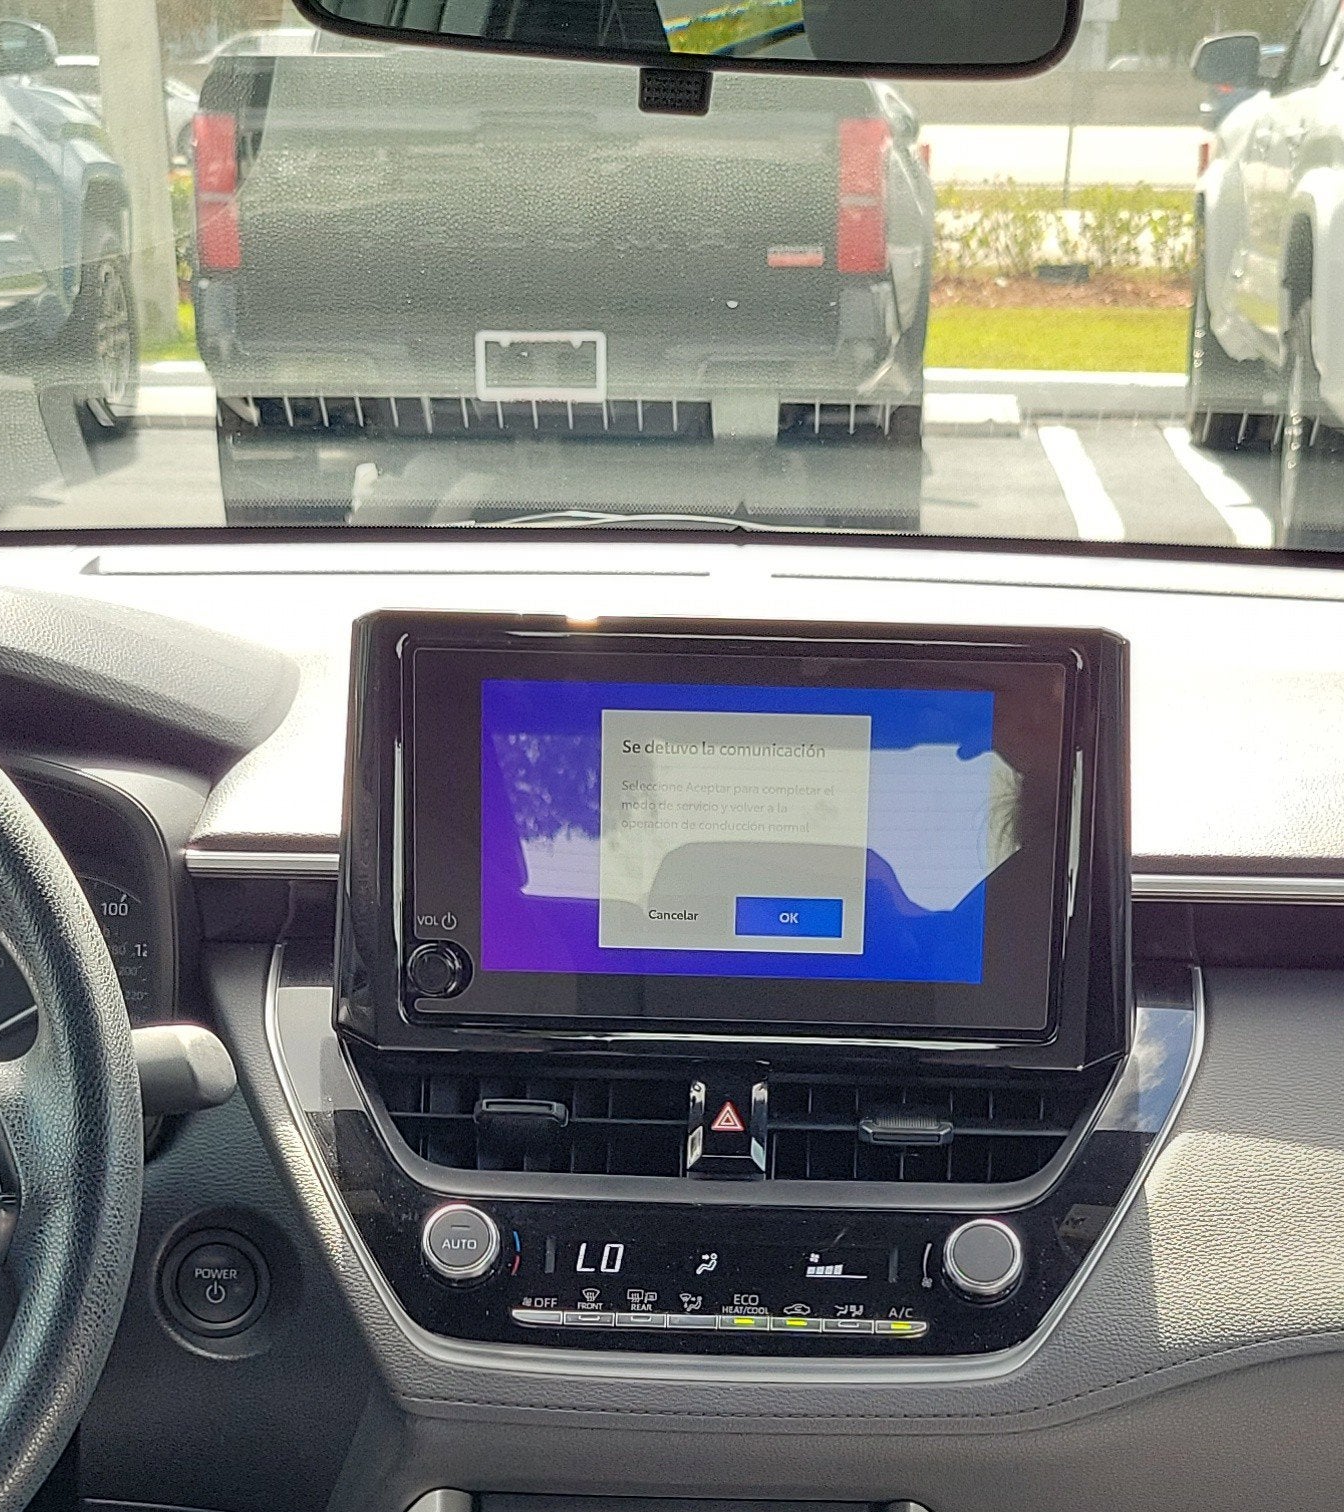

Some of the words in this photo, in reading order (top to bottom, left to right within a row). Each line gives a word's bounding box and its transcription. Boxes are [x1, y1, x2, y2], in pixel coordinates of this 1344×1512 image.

[622, 739, 641, 754] Se
[644, 739, 699, 755] detuvo
[702, 741, 715, 756] la
[719, 742, 826, 758] comunicación
[621, 780, 683, 792] Seleccione
[686, 782, 731, 795] Aceptar
[733, 785, 759, 796] para
[762, 784, 821, 797] completar
[823, 785, 835, 796] el
[621, 799, 656, 811] modo
[658, 799, 674, 811] de
[676, 800, 719, 812] servicio
[721, 804, 729, 814] y
[730, 802, 764, 813] volver
[767, 805, 774, 813] a
[777, 802, 788, 813] la
[681, 819, 696, 830] de
[768, 821, 810, 833] normal
[101, 902, 129, 916] 100
[417, 915, 439, 926] VOL
[648, 909, 699, 921] Cancelar
[779, 912, 799, 924] OK
[441, 1238, 477, 1250] AUTO
[576, 1242, 625, 1273] LO
[194, 1268, 238, 1280] POWER
[534, 1297, 558, 1308] OFF
[577, 1302, 603, 1310] FRONT
[733, 1294, 759, 1306] ECO
[630, 1303, 653, 1311] REAR
[721, 1305, 769, 1315] HEAT/COOL
[888, 1307, 914, 1318] A/C
